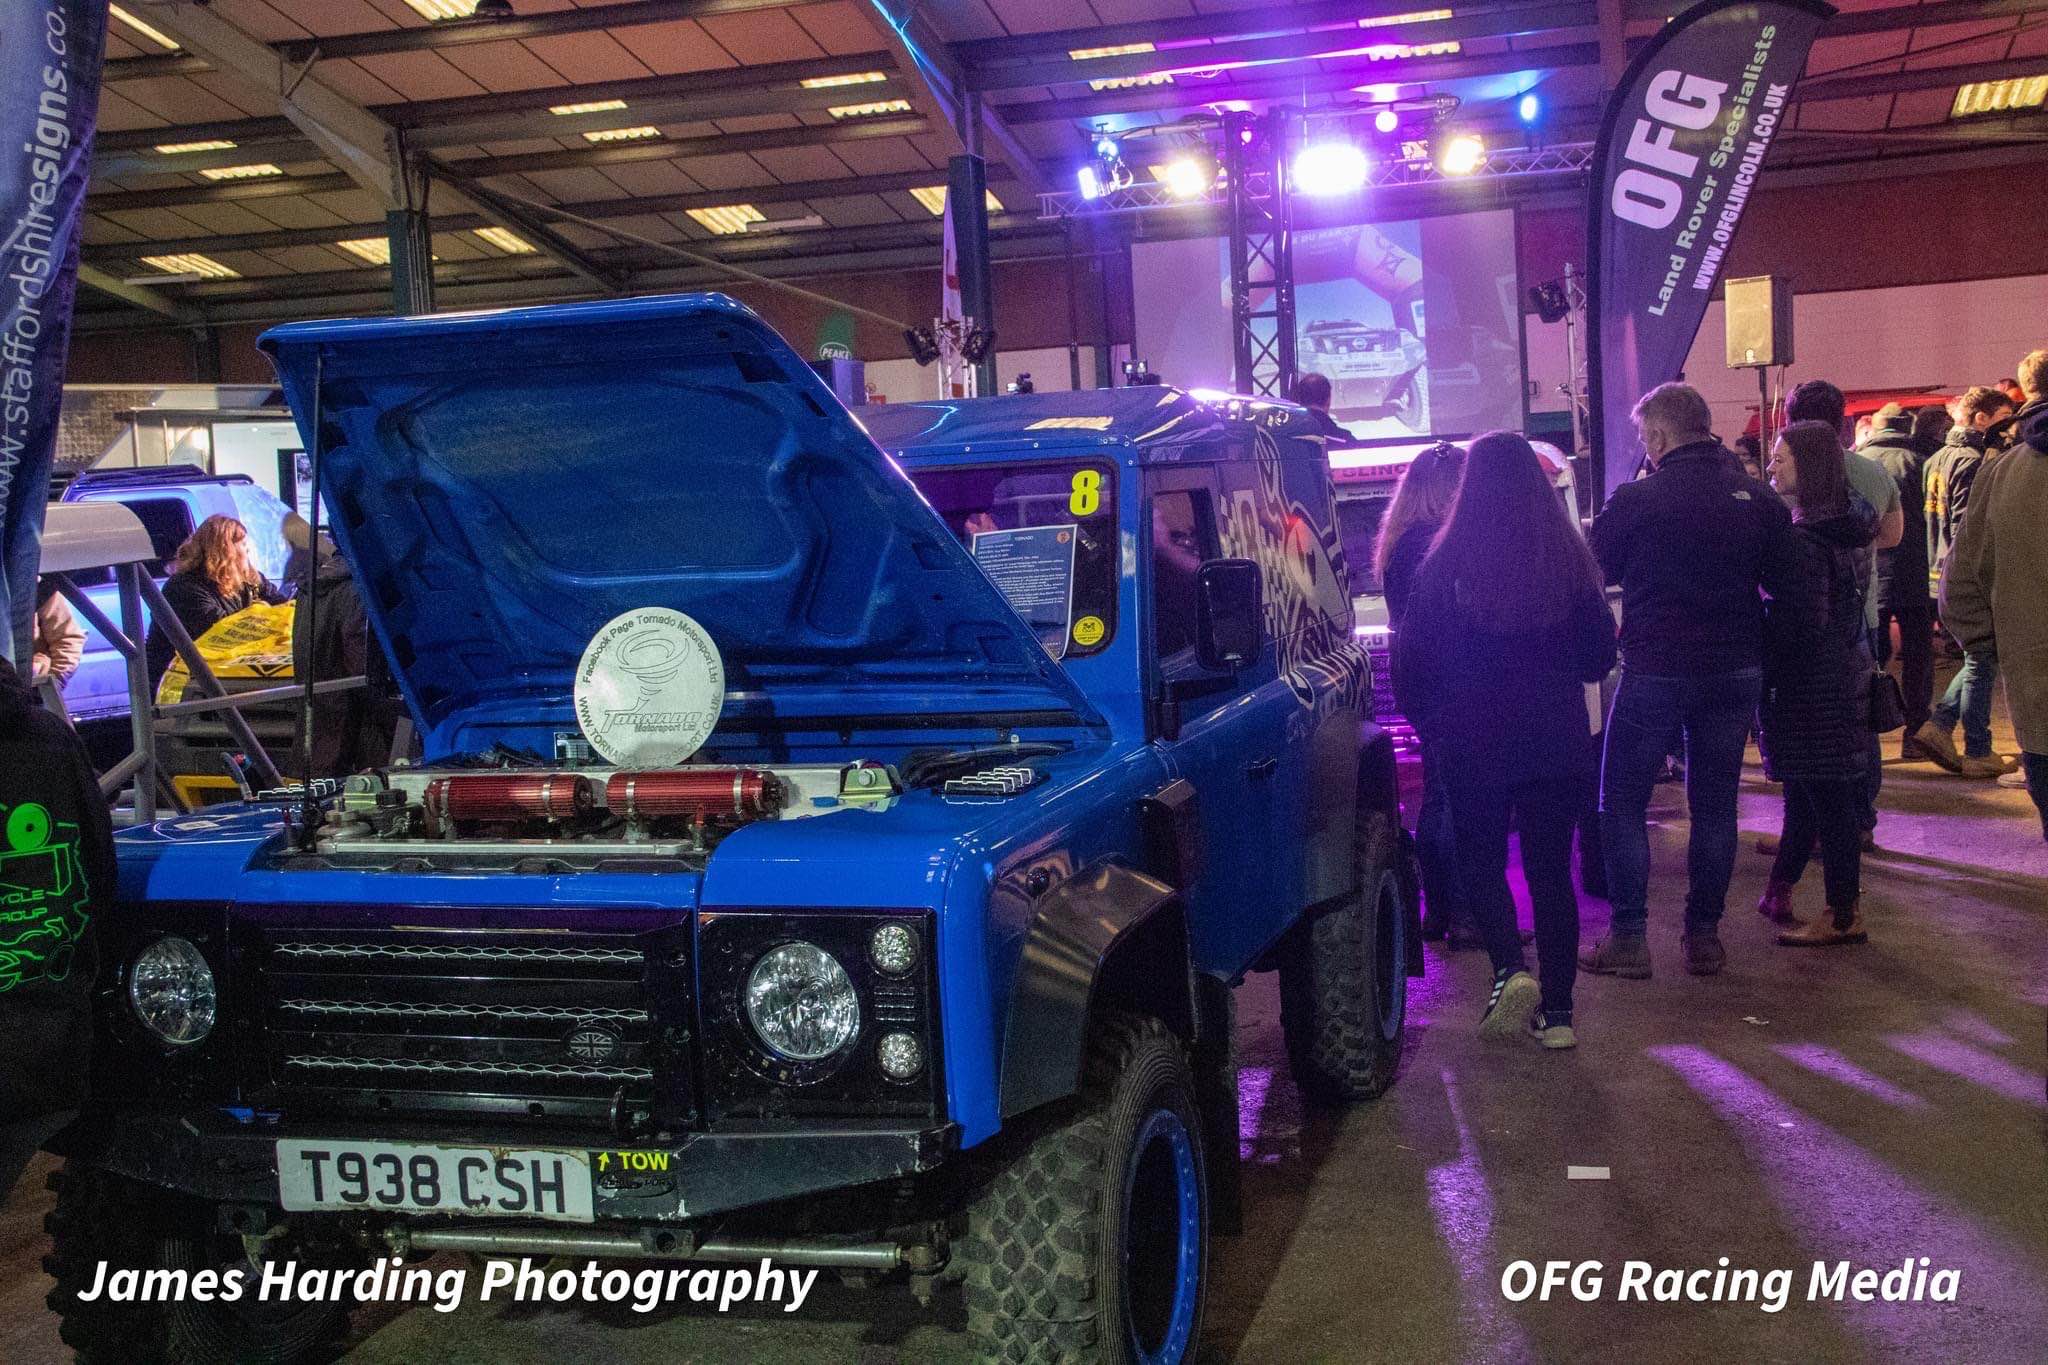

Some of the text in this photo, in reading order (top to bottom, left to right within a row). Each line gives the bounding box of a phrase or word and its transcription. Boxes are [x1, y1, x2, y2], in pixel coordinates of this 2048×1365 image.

[1611, 69, 1729, 230] OFG
[1648, 24, 1777, 317] Land Rover Specialists
[1692, 82, 1789, 291] WWW.OFGLINCOLN.CO.UK
[0, 6, 71, 531] ww.staffordshiresigns.co.
[1070, 470, 1100, 516] 8
[582, 614, 719, 684] Facebook Page Tornado Motorsport Ltd
[301, 1150, 564, 1213] T938 CSH
[617, 1152, 669, 1171] TOW
